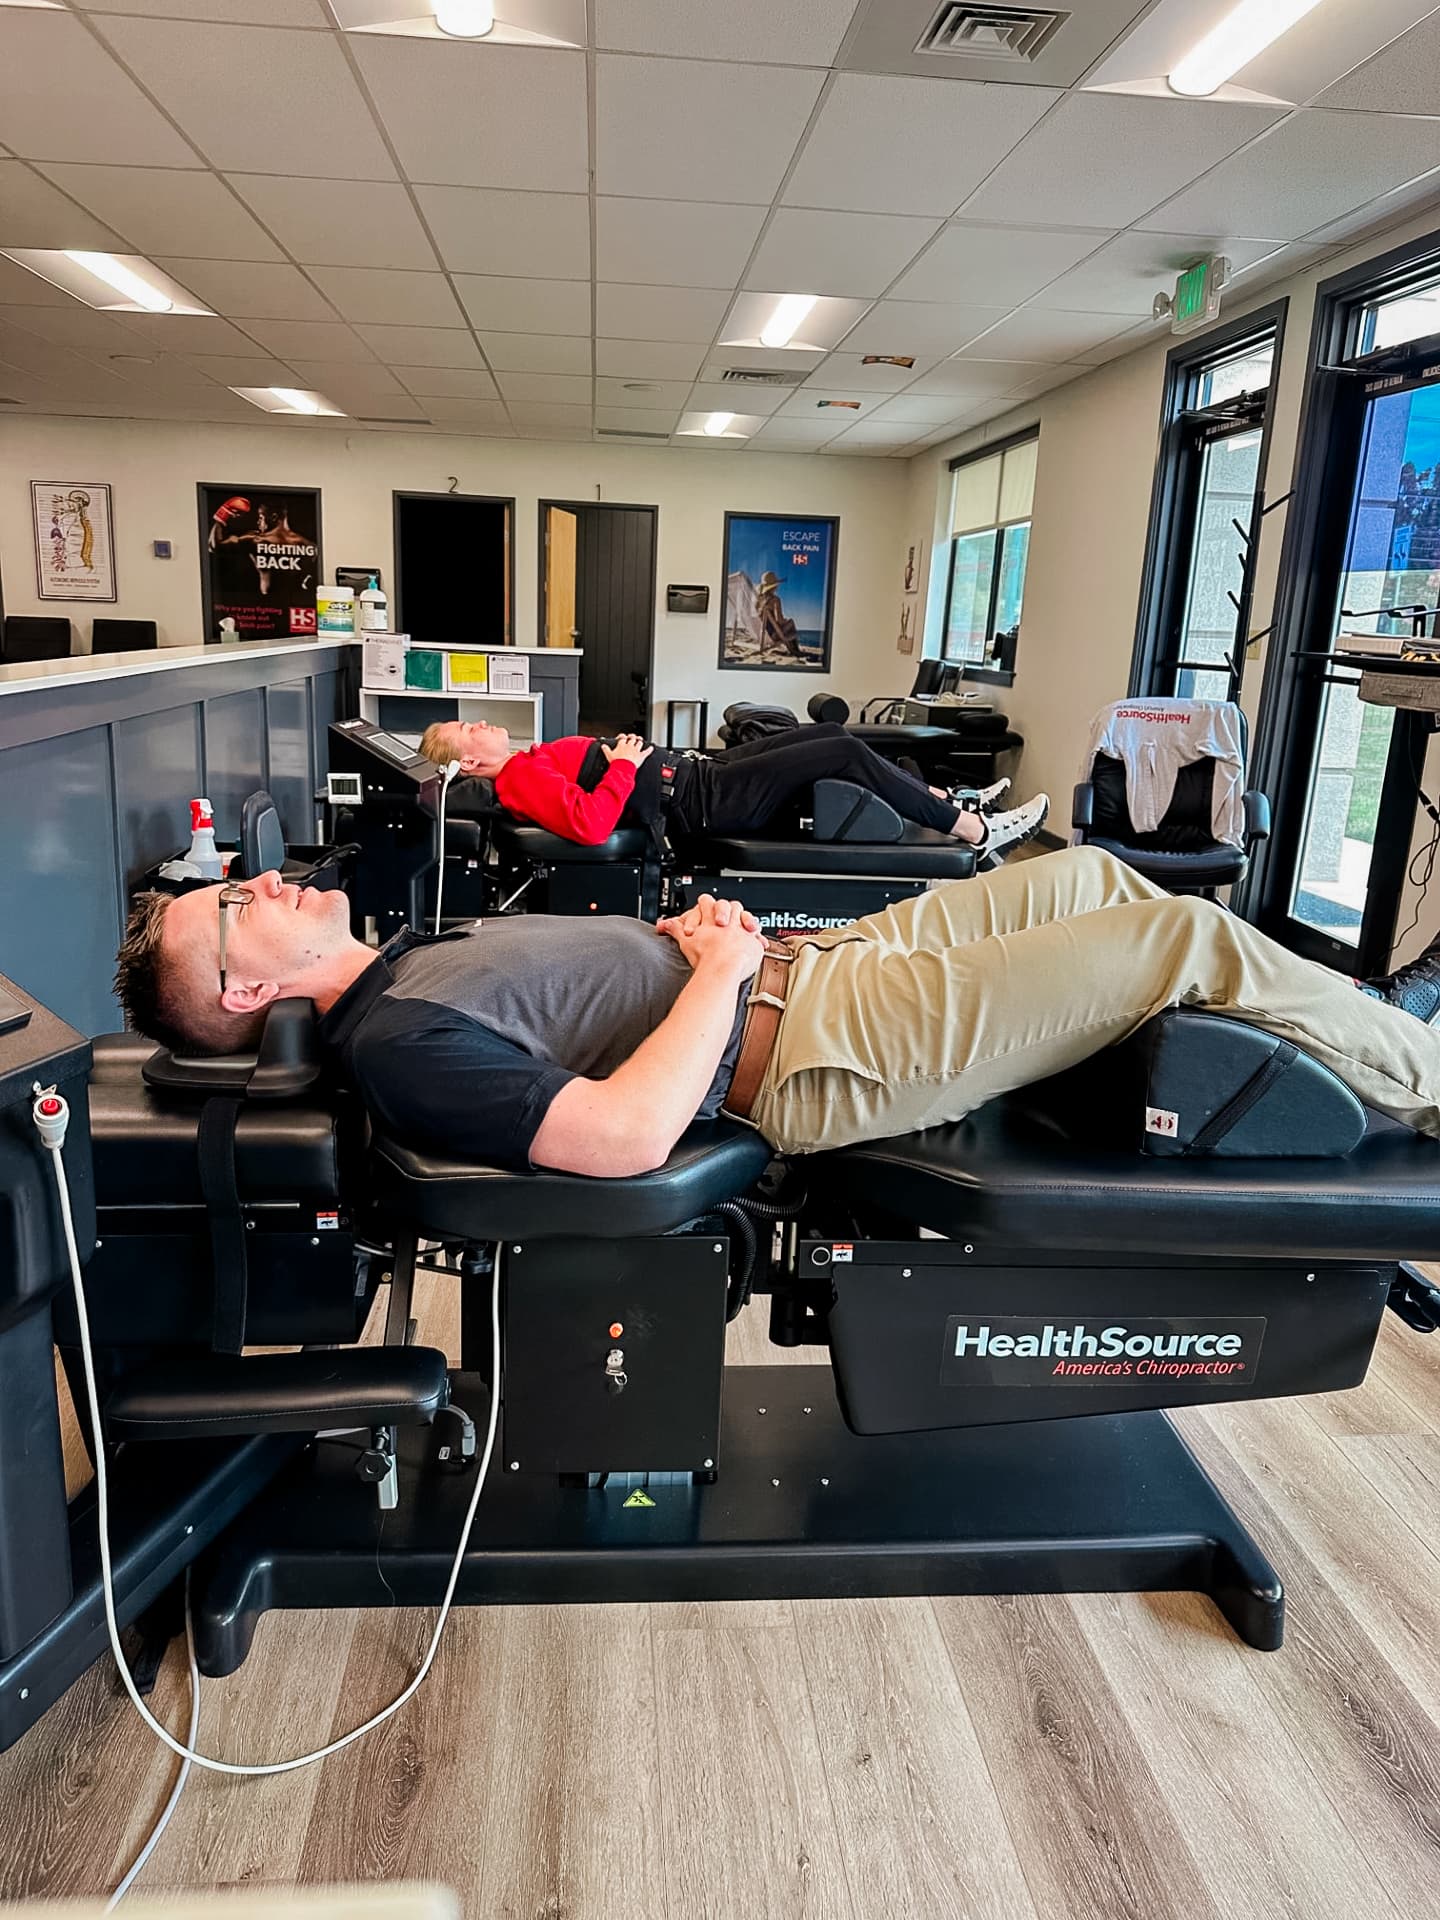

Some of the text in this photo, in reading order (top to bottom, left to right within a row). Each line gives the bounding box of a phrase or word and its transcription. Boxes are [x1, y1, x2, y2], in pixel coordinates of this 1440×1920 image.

[447, 476, 460, 494] 2
[595, 483, 602, 501] 1
[783, 531, 821, 542] ESCAPE
[256, 543, 315, 556] FIGHTING
[782, 543, 820, 552] BACK PAIN
[256, 555, 302, 571] BACK
[1116, 710, 1191, 724] HealthSource
[954, 1326, 1242, 1358] HealthSource
[1052, 1360, 1132, 1376] America's
